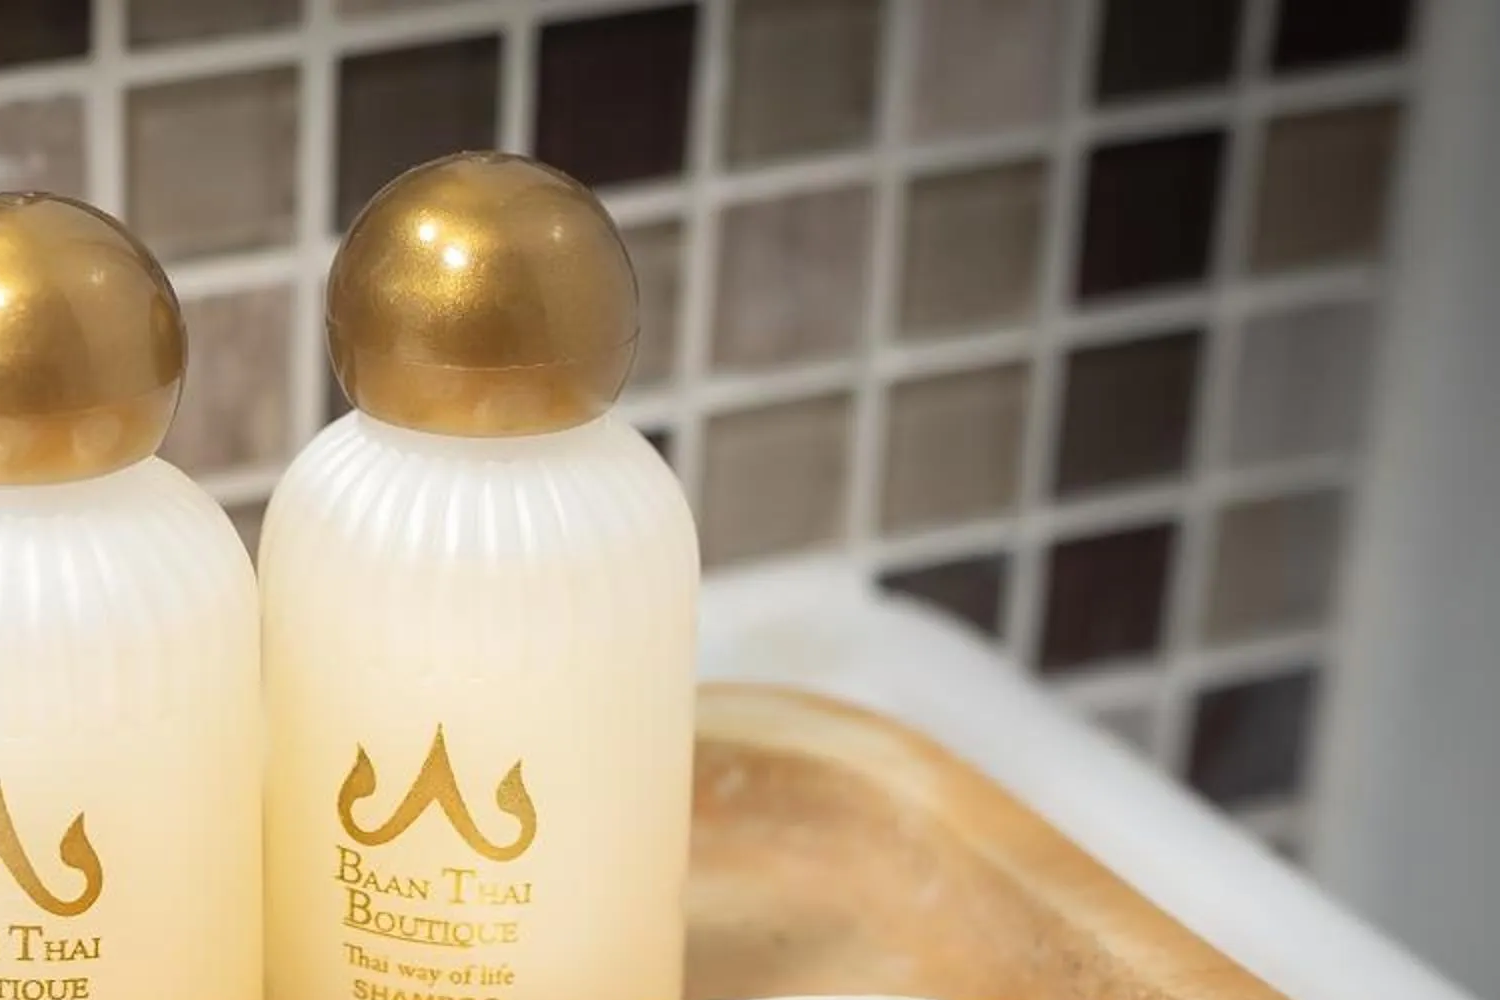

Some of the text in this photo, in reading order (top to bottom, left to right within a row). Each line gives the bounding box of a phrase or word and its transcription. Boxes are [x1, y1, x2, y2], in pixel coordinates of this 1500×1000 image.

[332, 845, 431, 900] BAAN
[344, 887, 518, 945] BOUTIQUE
[7, 924, 100, 961] THAI
[343, 942, 516, 987] Thai way of life
